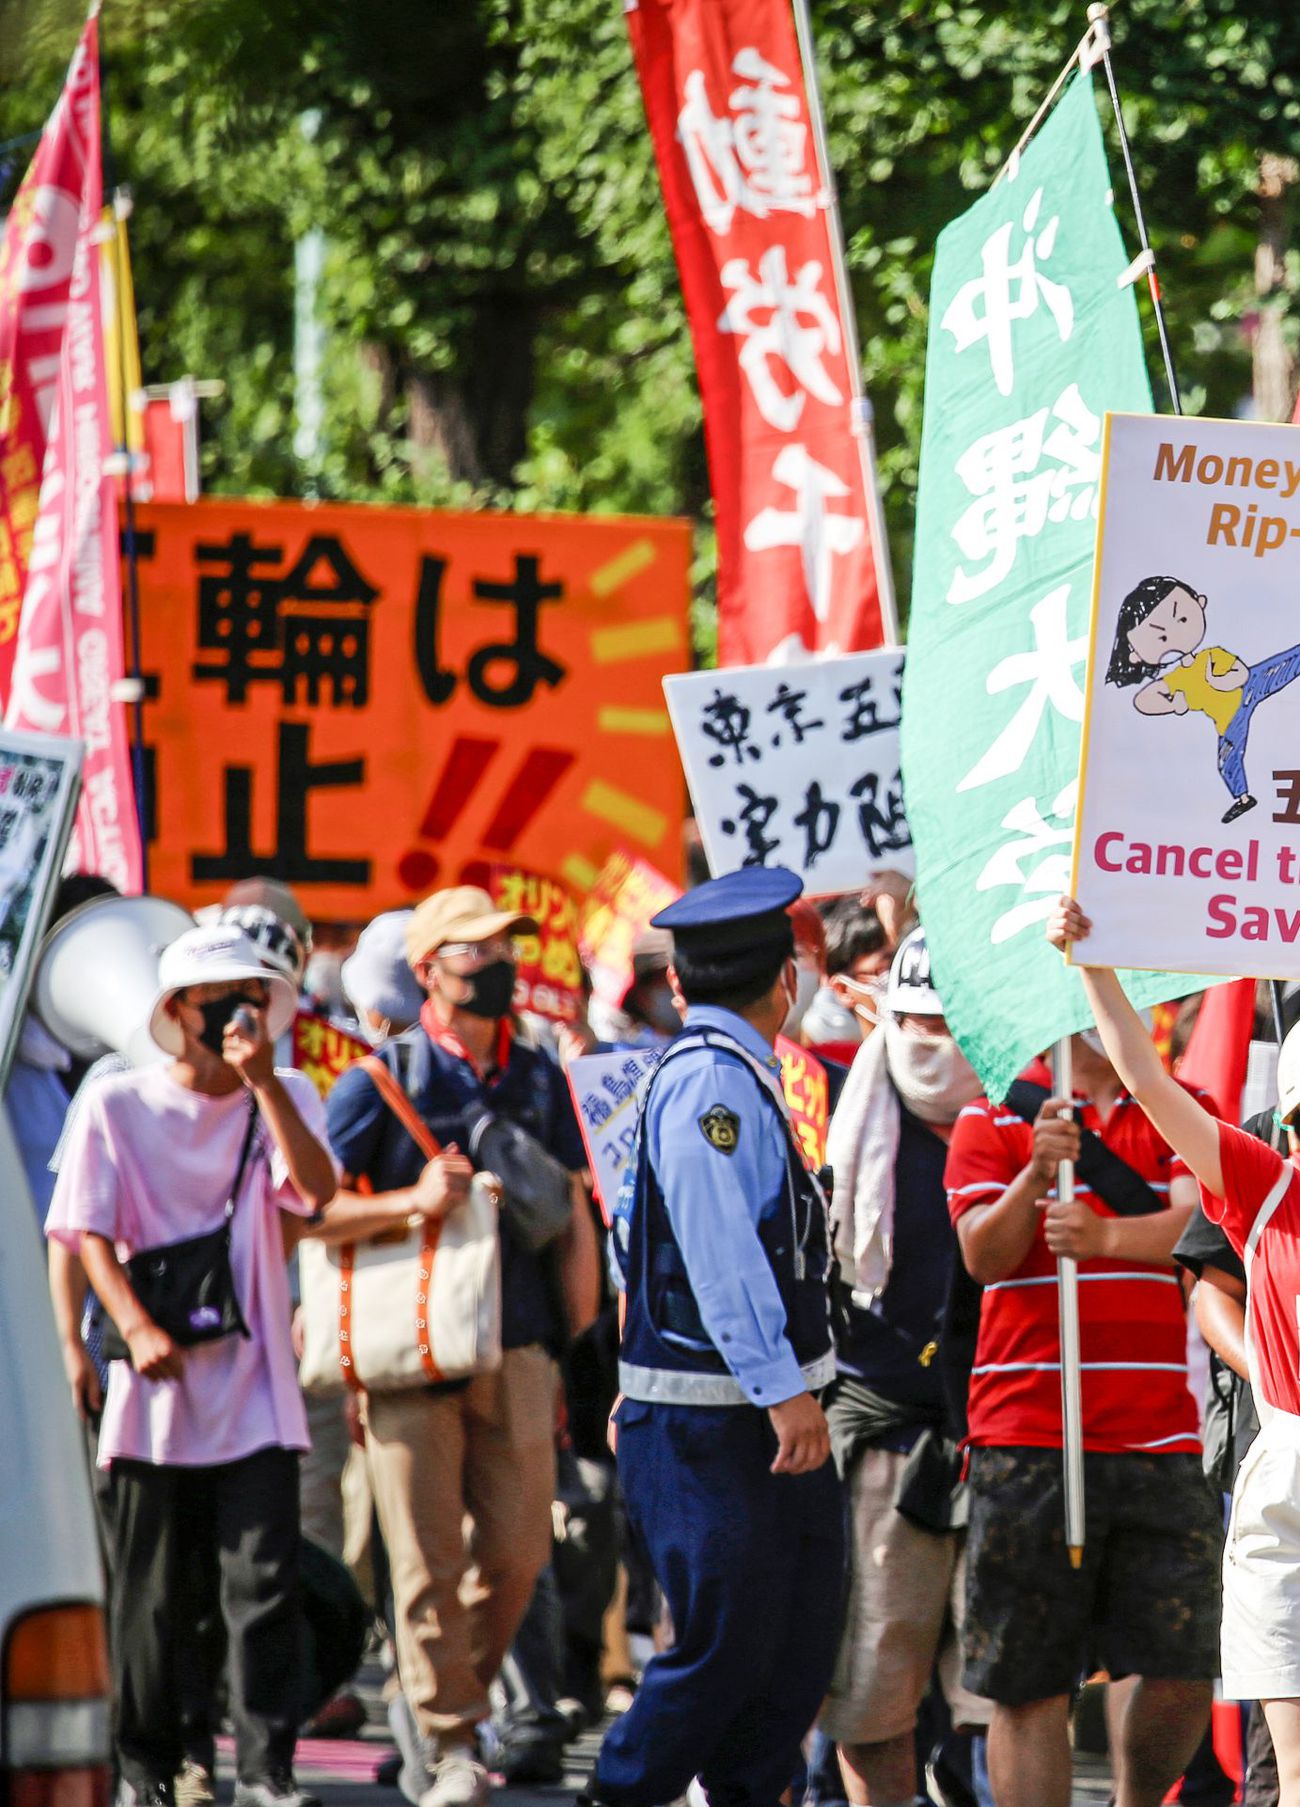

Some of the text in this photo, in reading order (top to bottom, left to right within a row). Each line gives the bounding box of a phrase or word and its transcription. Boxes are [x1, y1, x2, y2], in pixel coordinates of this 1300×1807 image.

[125, 530, 568, 708] 輪は
[702, 655, 905, 768] 東京五
[130, 718, 578, 892] 止!!
[1095, 831, 1260, 882] Cancel
[498, 872, 579, 930] オリン
